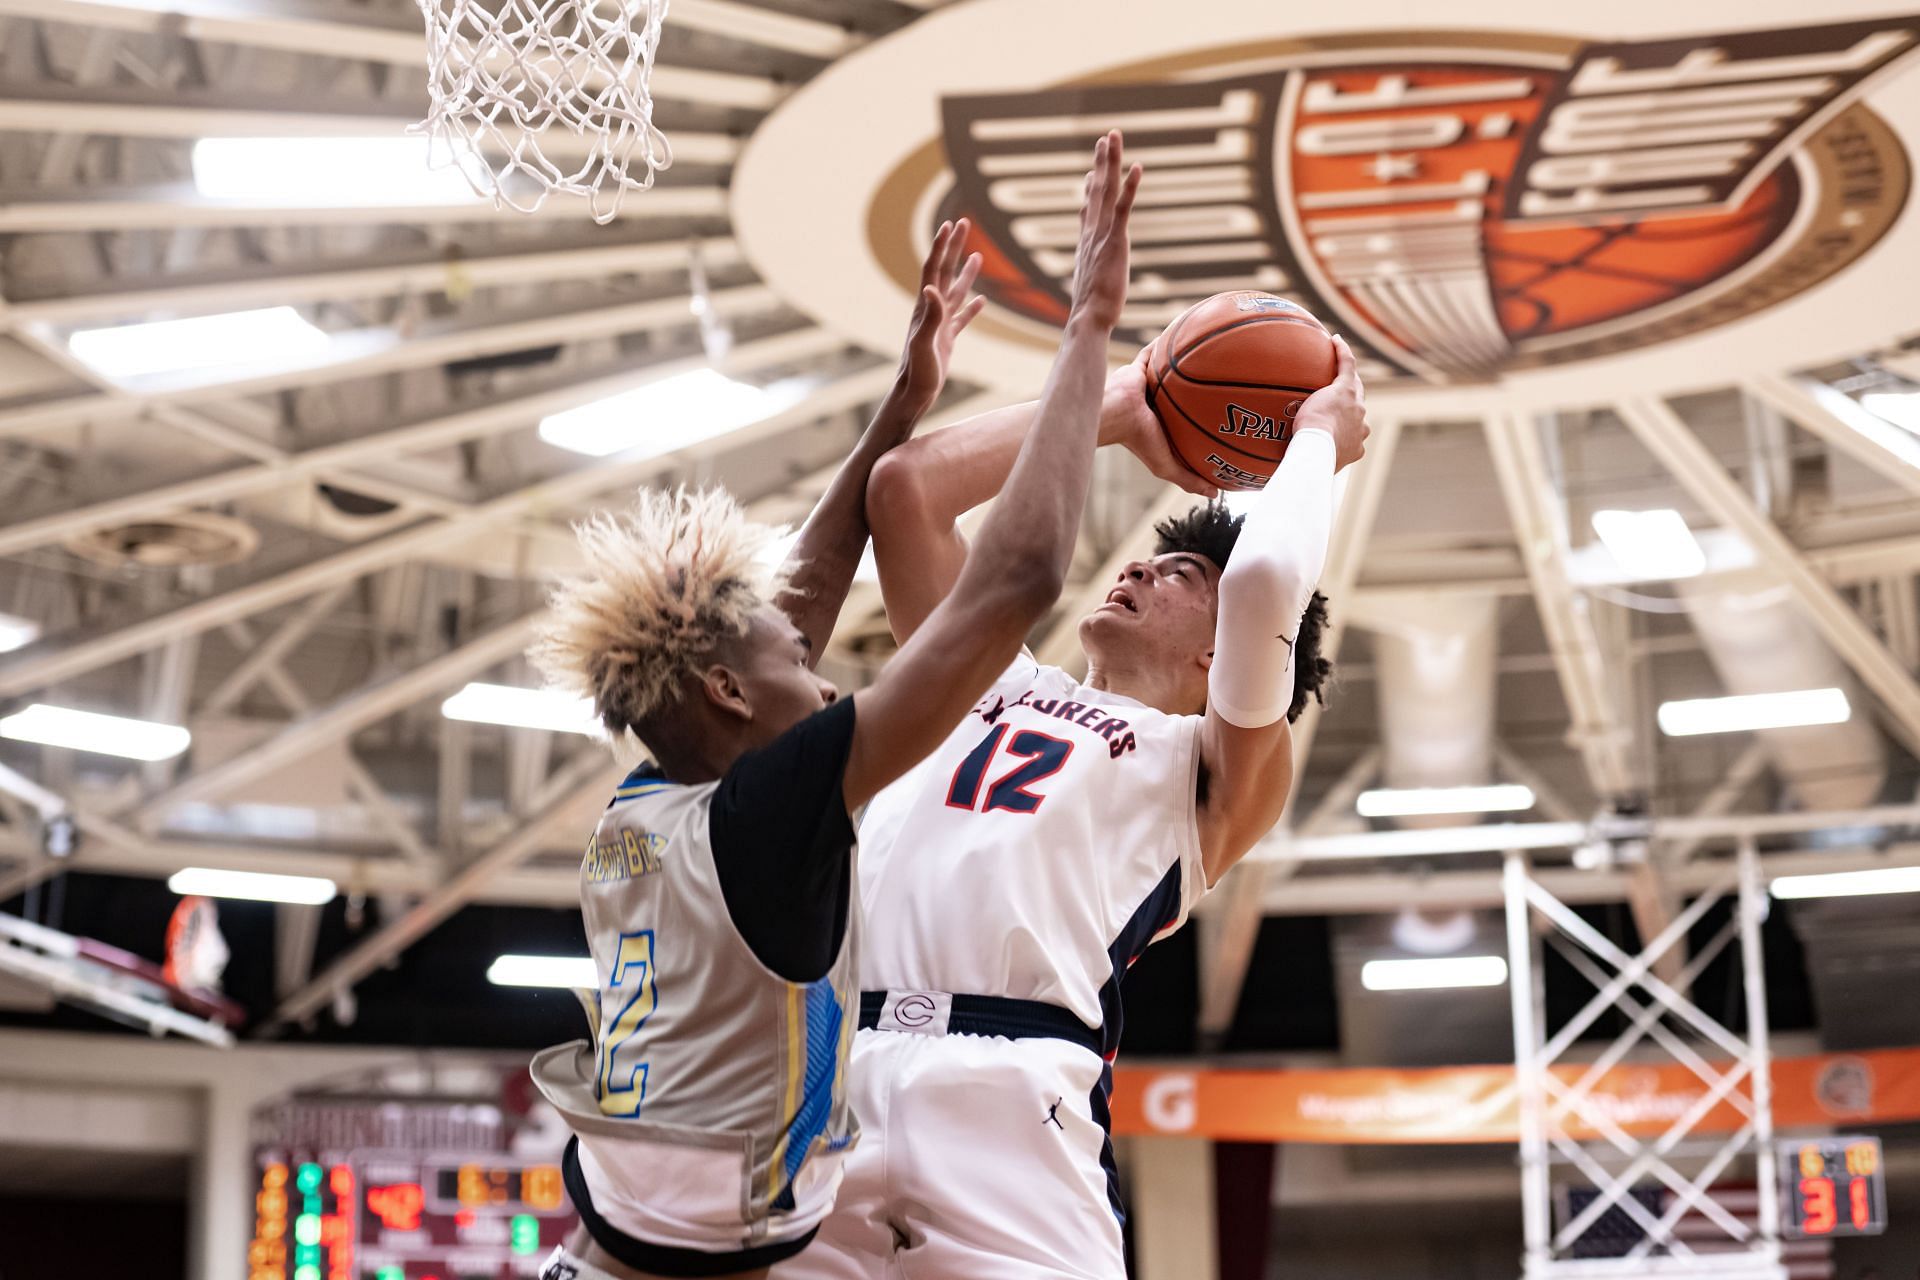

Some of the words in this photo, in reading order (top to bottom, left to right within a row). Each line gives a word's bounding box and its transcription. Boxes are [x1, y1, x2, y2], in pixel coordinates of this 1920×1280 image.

[1296, 75, 1535, 156] OF
[1519, 29, 1912, 217] FAME
[1219, 403, 1287, 441] SPAL
[1206, 453, 1271, 484] PREC
[966, 689, 1136, 760] XLORERS
[945, 722, 1074, 814] 12
[599, 929, 657, 1118] 2
[894, 994, 935, 1026] C
[1143, 1075, 1197, 1130] G
[1798, 1176, 1870, 1234] 31
